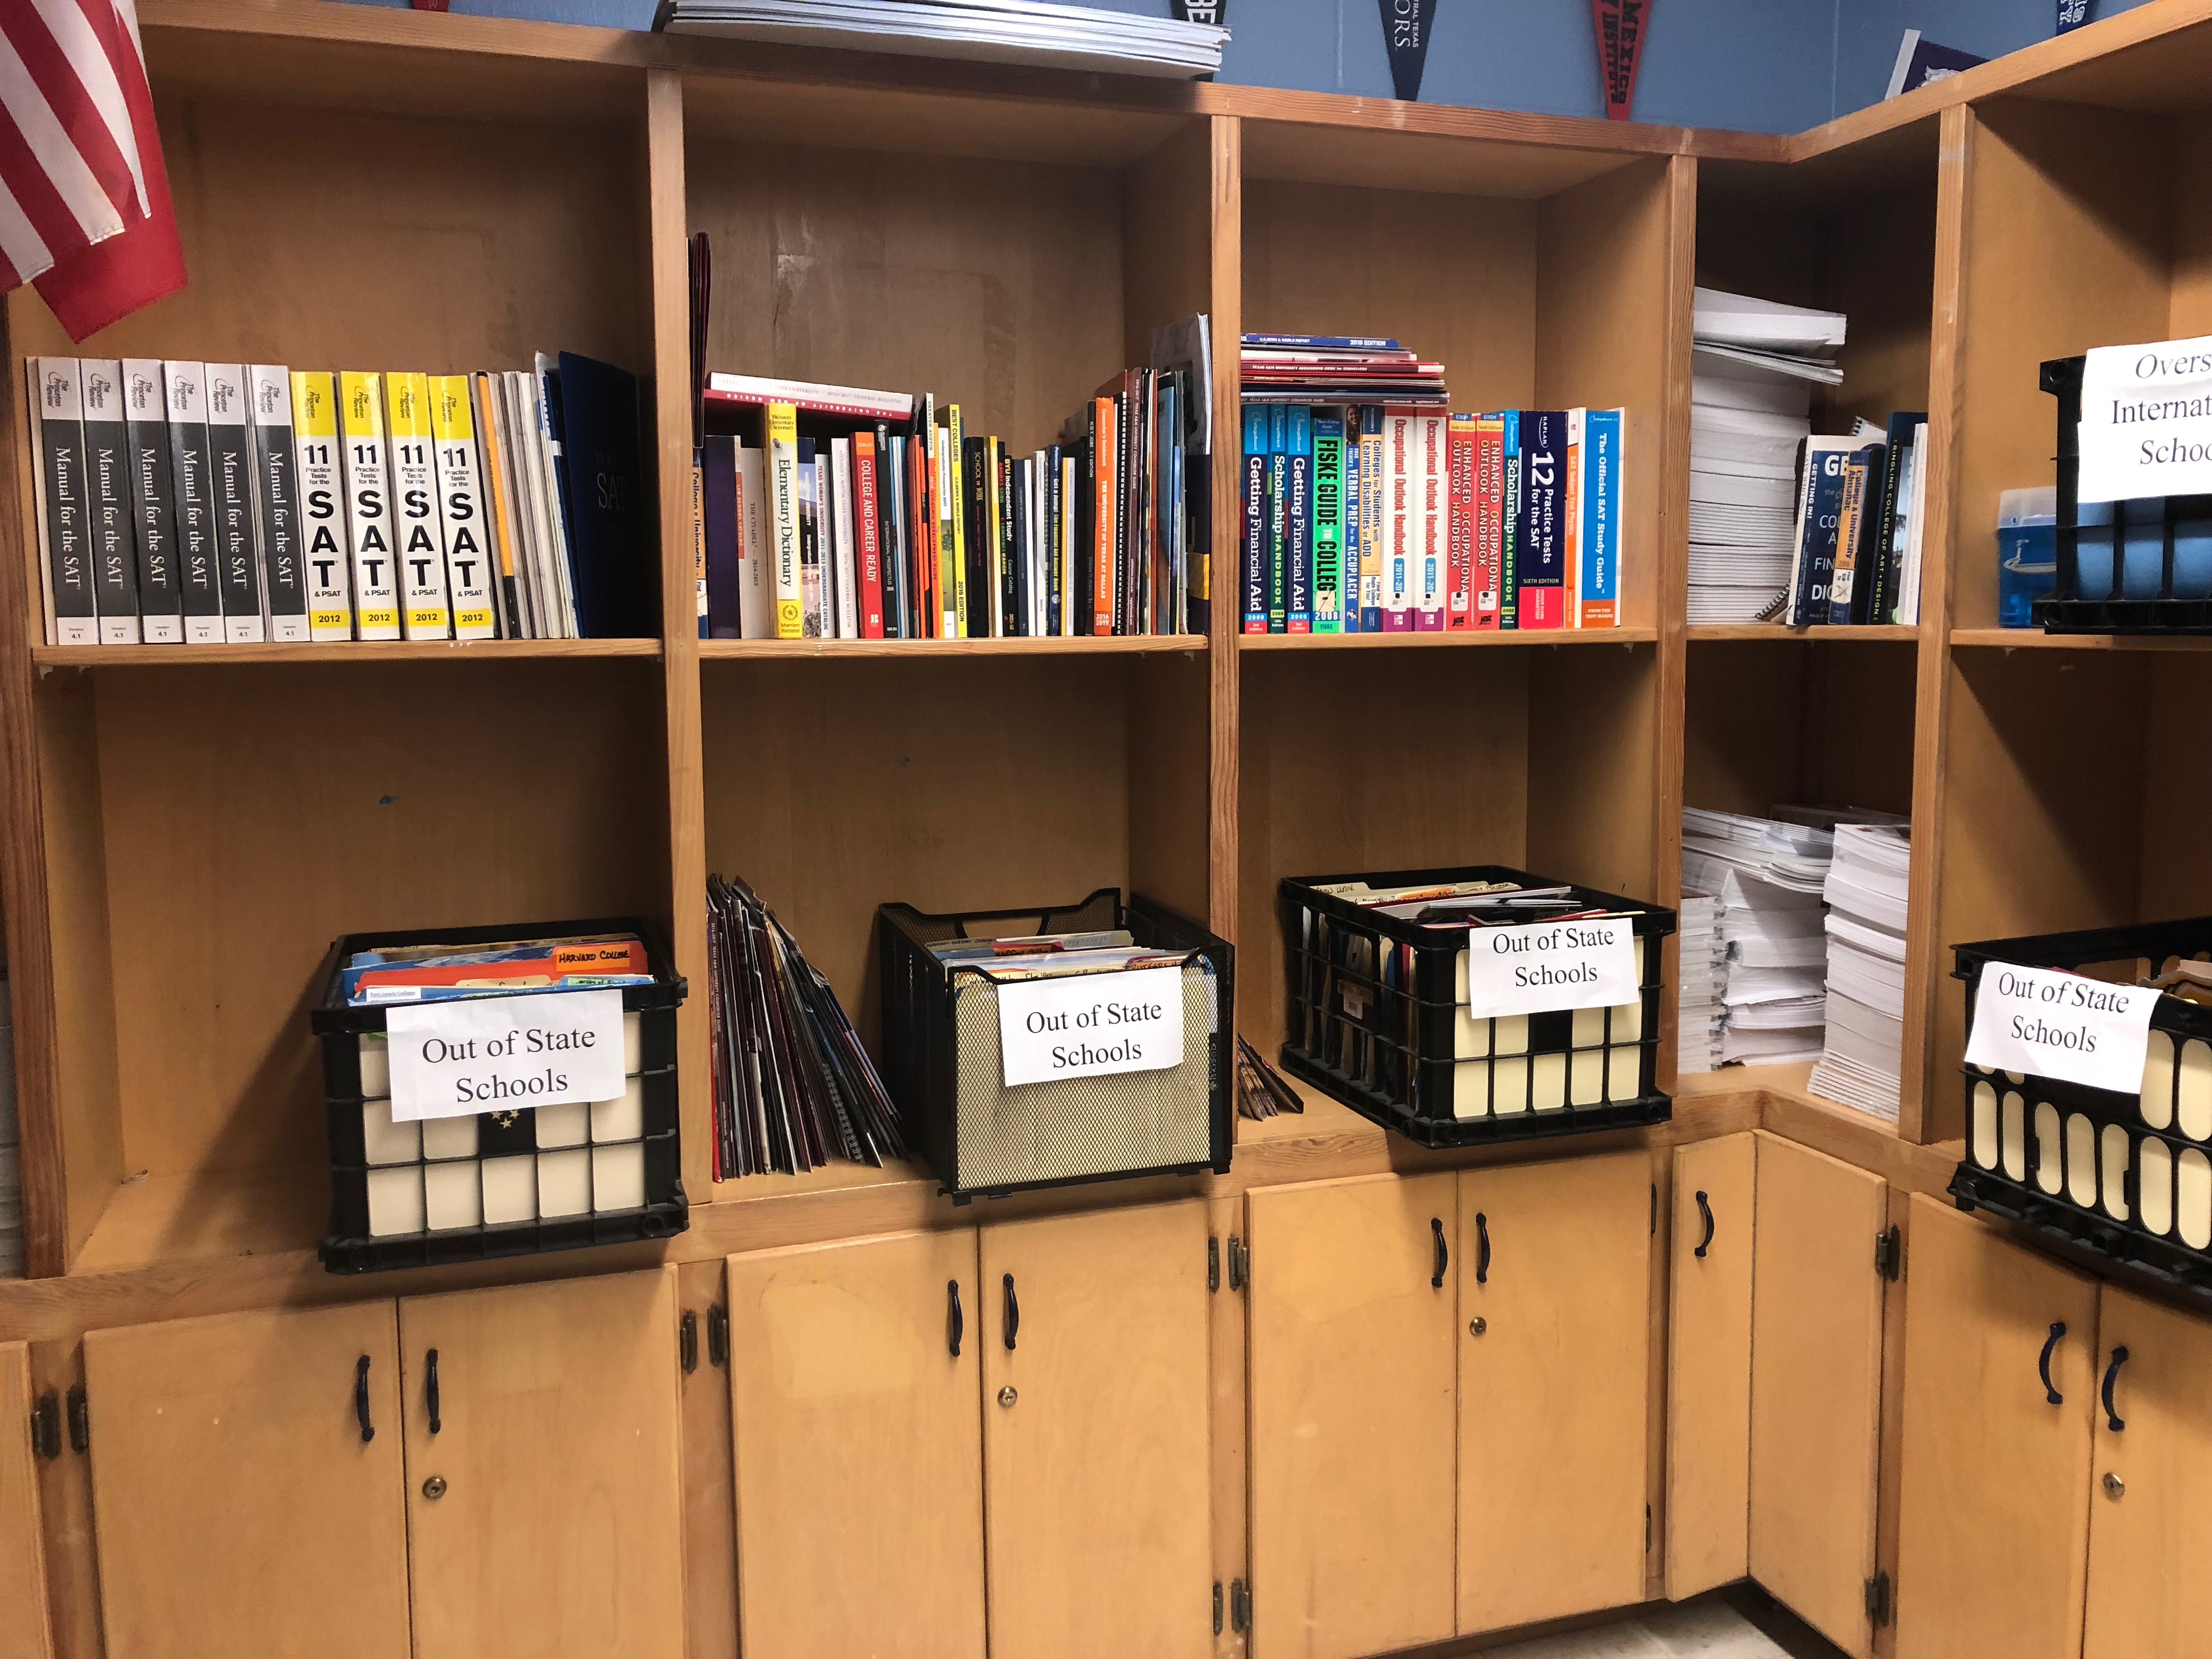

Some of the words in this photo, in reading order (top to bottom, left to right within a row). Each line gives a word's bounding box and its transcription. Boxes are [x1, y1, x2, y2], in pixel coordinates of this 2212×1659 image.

[2135, 353, 2212, 380] Overs
[2111, 394, 2212, 425] Internat
[304, 445, 328, 464] 11
[354, 445, 376, 464] 11
[400, 445, 423, 464] 11
[443, 448, 466, 466] 11
[1317, 439, 1338, 480] FISKE
[1362, 440, 1372, 479] Learning
[1372, 440, 1381, 478] Colleges
[1393, 419, 1407, 475] Occupational
[1425, 419, 1438, 475] Occupational
[1599, 432, 1607, 454] The
[57, 447, 75, 500] Manual
[99, 448, 117, 501] Manual
[142, 448, 160, 501] Manual
[183, 450, 201, 502] Manual
[861, 460, 874, 498] COLLEGE
[1452, 439, 1460, 495] OUTLOOK
[1462, 441, 1472, 504] ENHANCED
[1480, 439, 1488, 494] OUTLOOK
[1490, 441, 1500, 503] ENHANCED
[1532, 452, 1554, 486] 12
[1598, 456, 1607, 496] Official
[778, 459, 791, 524] Elementary
[1248, 456, 1262, 516] Getting
[1272, 455, 1285, 534] Scholarship
[1291, 457, 1306, 516] Getting
[1347, 469, 1359, 501] VERBAL
[1394, 478, 1406, 511] Outlook
[1426, 478, 1438, 511] Outlook
[1504, 459, 1518, 534] Scholarship
[1532, 488, 1541, 504] for
[1844, 470, 1857, 511] Almanac
[1852, 470, 1864, 505] College
[60, 505, 76, 525] for
[103, 506, 118, 526] for
[146, 506, 161, 525] for
[188, 507, 202, 526] for
[864, 499, 874, 517] AND
[1316, 483, 1338, 526] GUIDE
[1347, 504, 1359, 527] PREP
[1362, 482, 1372, 529] Disabilities
[1373, 489, 1381, 527] Students
[1531, 506, 1541, 525] the
[1543, 488, 1554, 533] Practice
[1598, 498, 1606, 521] SAT
[62, 530, 77, 551] the
[105, 530, 120, 551] the
[148, 529, 163, 550] the
[189, 531, 204, 551] the
[864, 518, 876, 552] CAREER
[1102, 533, 1107, 541] OF
[1250, 517, 1262, 582] Financial
[1293, 517, 1306, 582] Financial
[1323, 528, 1333, 539] TO
[1362, 539, 1372, 557] ADD
[1394, 514, 1406, 556] Handbook
[1425, 514, 1438, 556] Handbook
[1451, 501, 1460, 567] HANDBOOK
[1479, 501, 1487, 567] HANDBOOK
[1488, 510, 1499, 591] OCCUPATIONA
[1530, 527, 1540, 549] SAT
[1543, 535, 1553, 563] Tests
[1596, 523, 1605, 555] Study
[1846, 514, 1858, 560] University
[780, 525, 794, 587] Dictionary
[866, 554, 877, 582] READY
[1460, 511, 1471, 592] OCCUPATIONA
[1505, 535, 1514, 602] HANDBOOK
[64, 556, 81, 587] SAT
[106, 556, 123, 587] SAT
[150, 556, 167, 586] SAT
[192, 556, 207, 587] SAT
[1101, 565, 1107, 573] AT
[1274, 534, 1283, 604] HANDBOOK
[1316, 540, 1337, 598] COLLEG
[1346, 545, 1358, 599] ACCUPLACER
[1596, 556, 1605, 589] Guide
[1250, 583, 1262, 612] Aid
[1293, 583, 1306, 611] Aid
[1314, 611, 1338, 620] 2008
[558, 952, 597, 963] HARVARD
[1493, 933, 1531, 955] Out
[1538, 930, 1562, 951] of
[1566, 927, 1615, 948] State
[1515, 962, 1598, 988] Schools
[1999, 972, 2034, 999] Out
[2041, 980, 2072, 1004] of
[2072, 983, 2130, 1014] State
[1025, 1011, 1071, 1035] Out
[1076, 1004, 1104, 1027] of
[1108, 1000, 1163, 1024] State
[2011, 1015, 2097, 1053] Schools
[421, 1037, 477, 1064] Out
[486, 1030, 518, 1059] of
[526, 1027, 596, 1054] State
[1052, 1038, 1142, 1069] Schools
[456, 1068, 569, 1104] Schools
